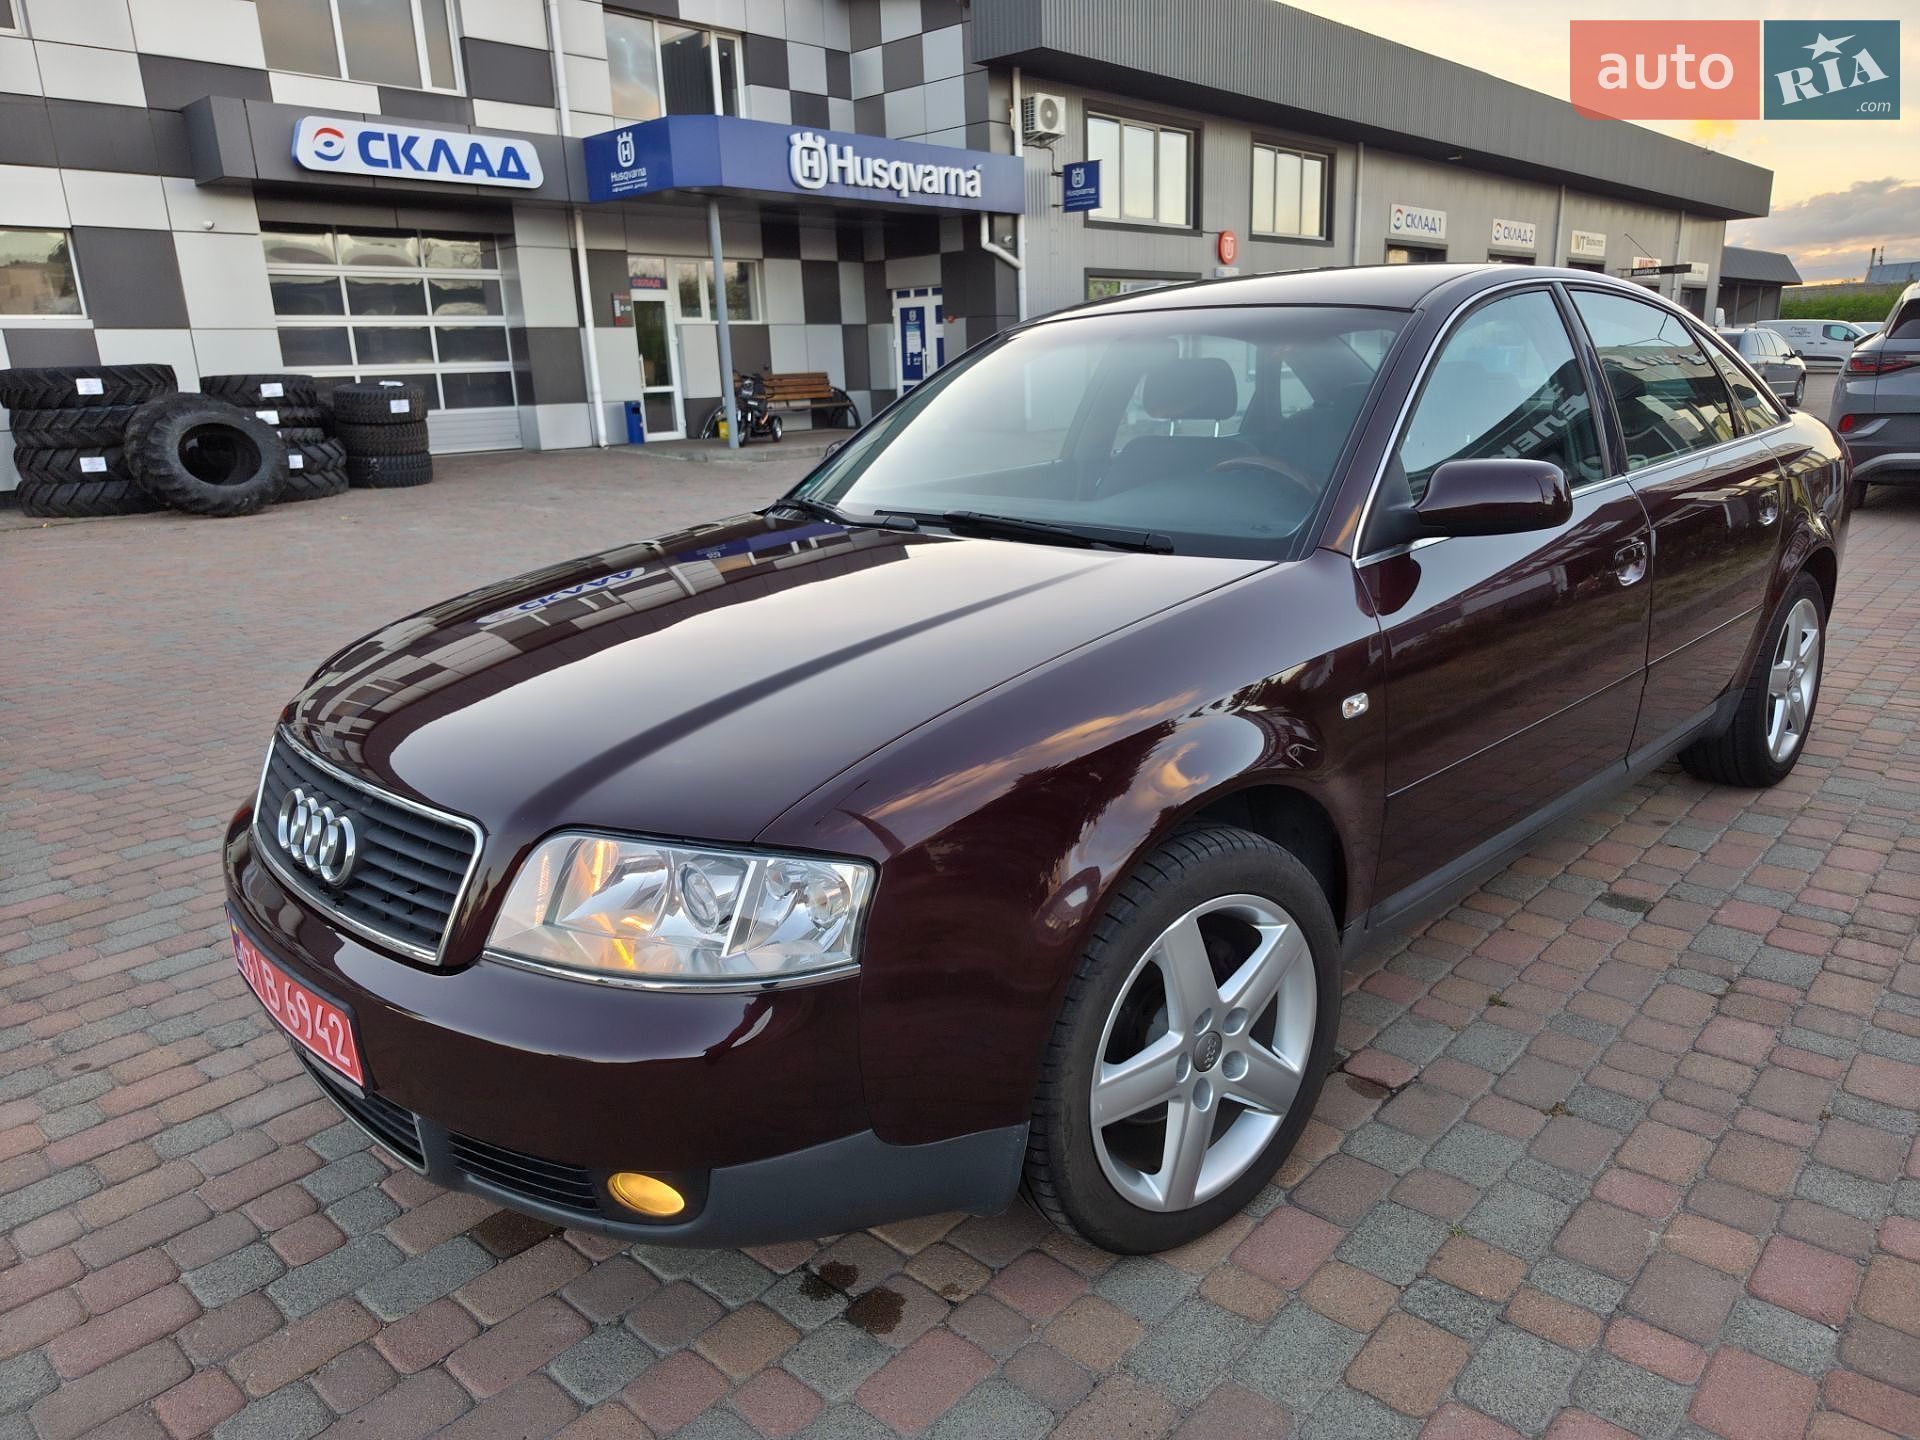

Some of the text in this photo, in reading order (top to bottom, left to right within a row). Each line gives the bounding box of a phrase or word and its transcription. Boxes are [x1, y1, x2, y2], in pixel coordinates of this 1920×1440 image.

[358, 131, 531, 181] СКЛАД
[827, 143, 982, 197] Husqvarna
[1405, 213, 1437, 233] СКЛАД
[1503, 226, 1533, 243] СКЛАД 2
[284, 981, 351, 1068] 6942
